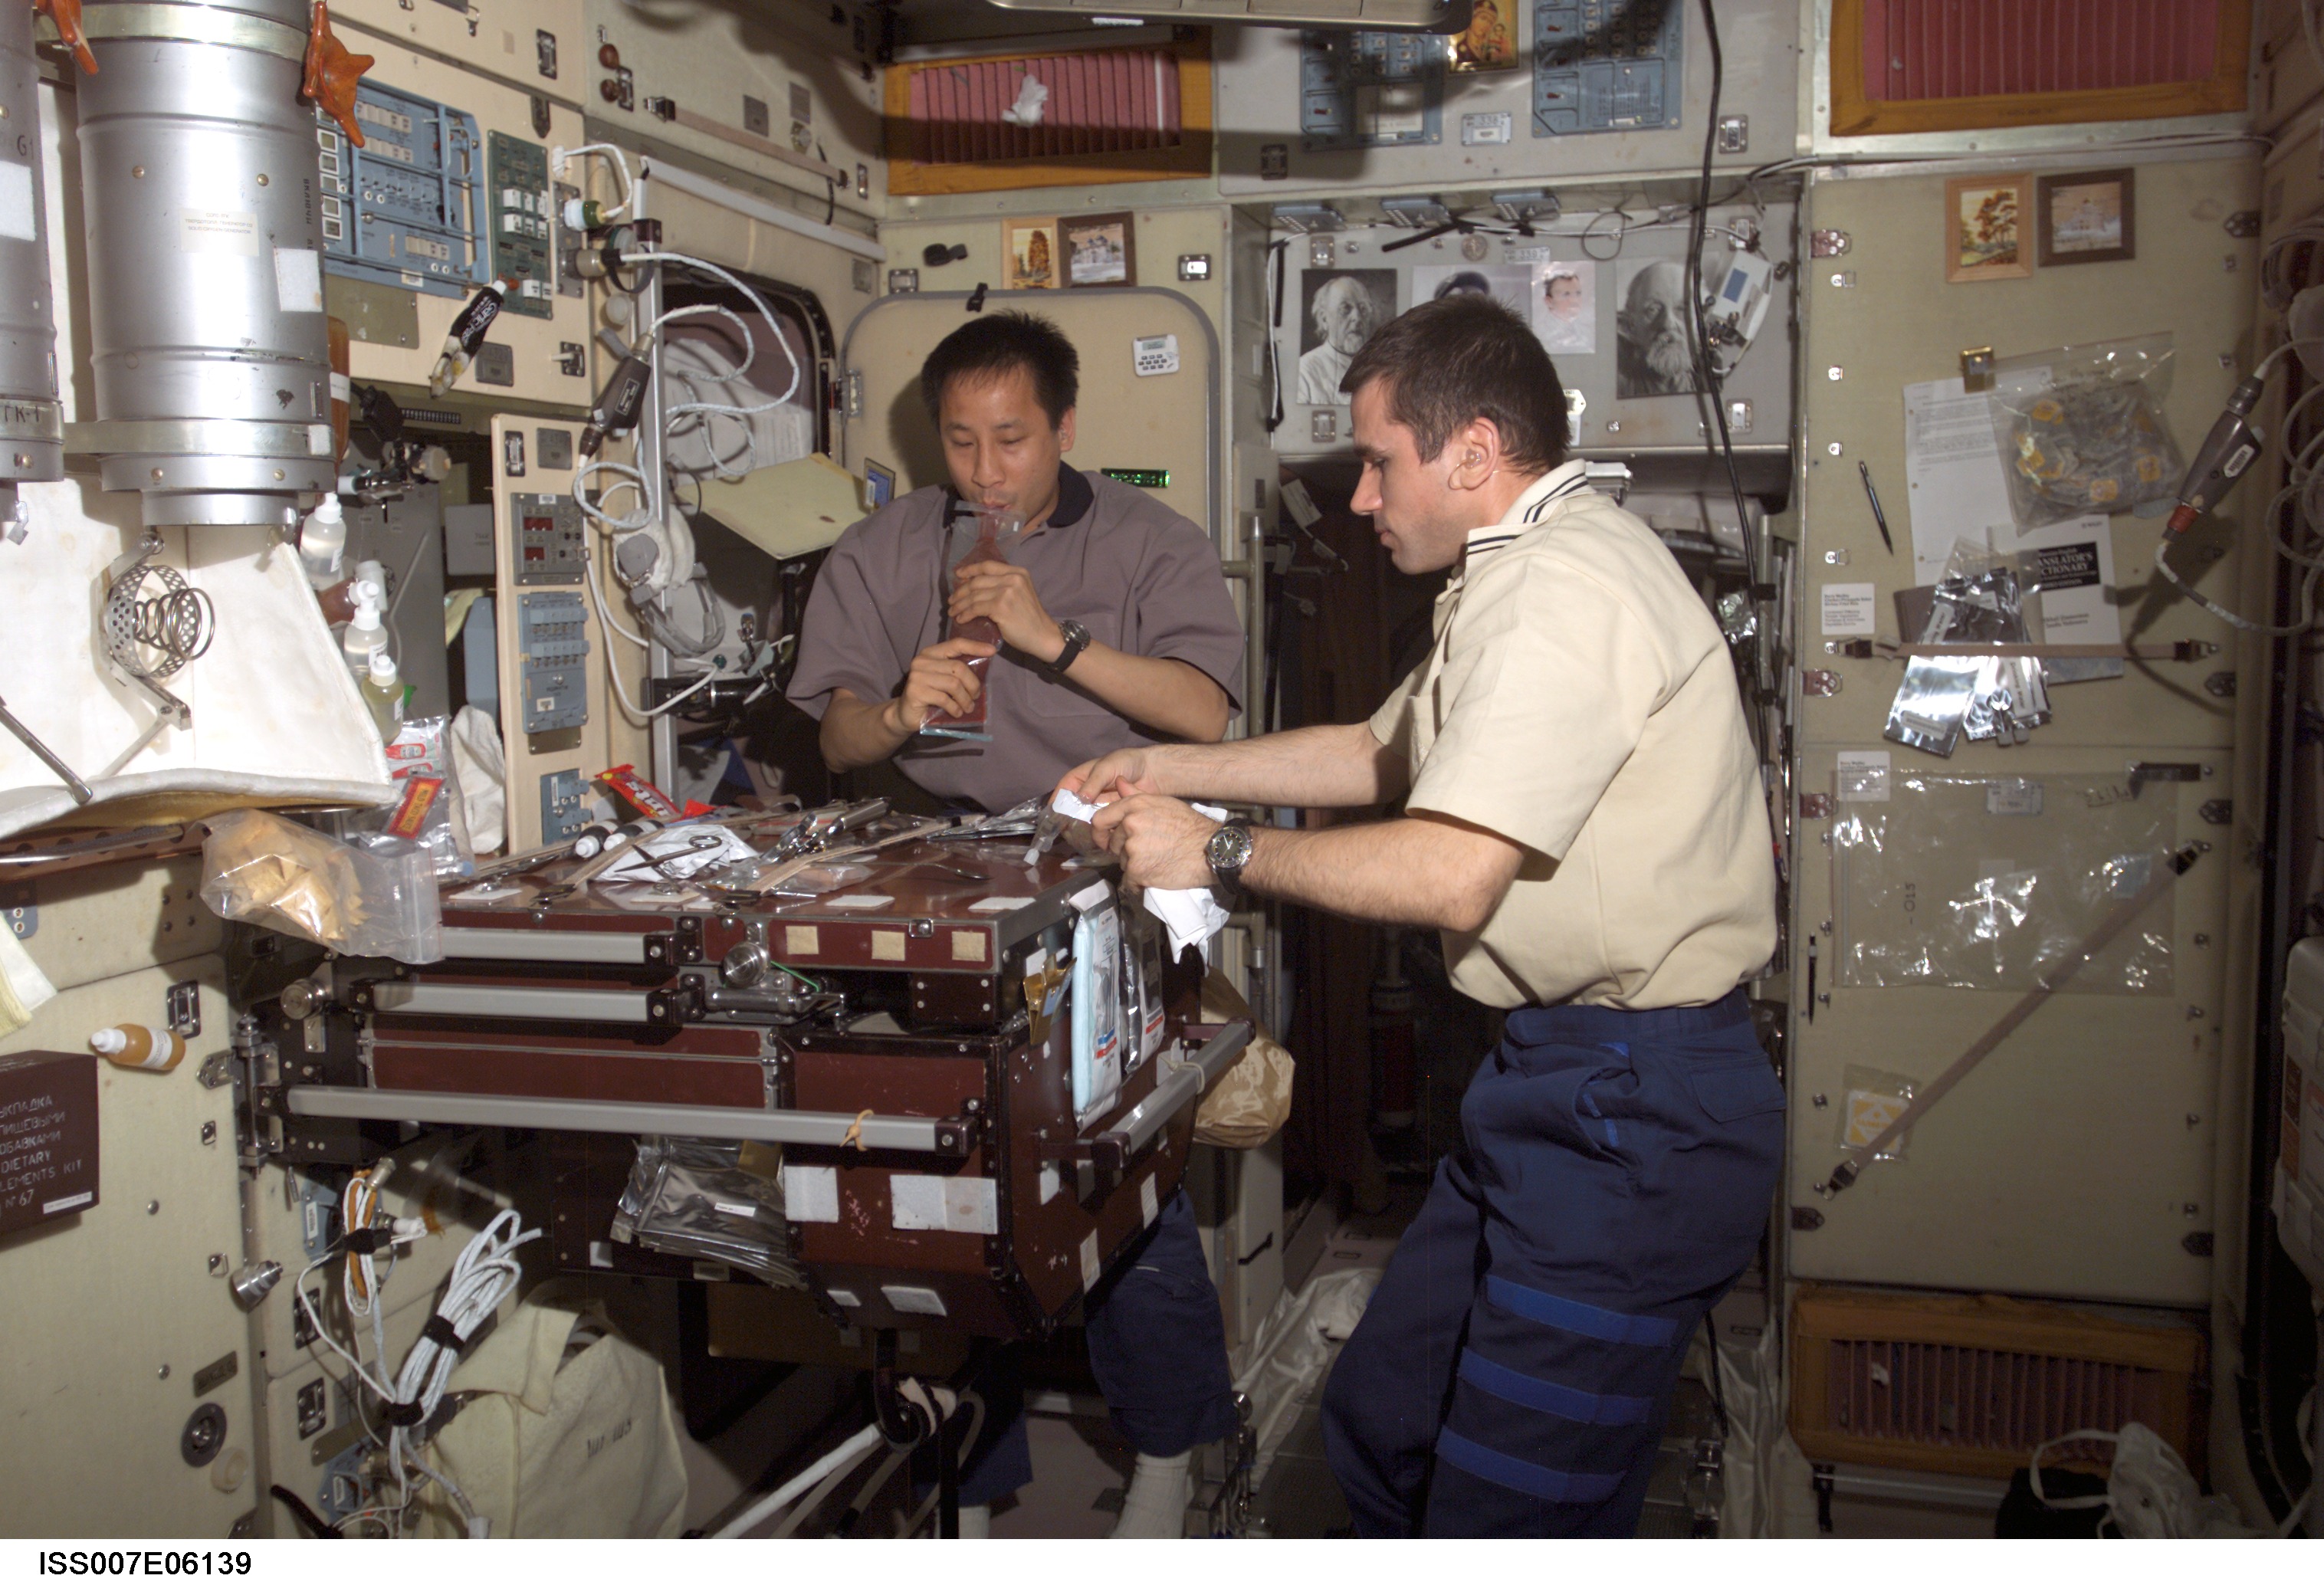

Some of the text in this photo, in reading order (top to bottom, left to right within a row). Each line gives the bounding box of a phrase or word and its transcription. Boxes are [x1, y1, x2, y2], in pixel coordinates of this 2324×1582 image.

[2037, 551, 2093, 567] ANSLATOR'S
[2040, 563, 2089, 576] CTIONARY
[0, 1131, 61, 1155] ОБАВКАМИ
[2, 1150, 51, 1173] DIETARY
[0, 1158, 82, 1193] LEMENTS KIT
[19, 1188, 34, 1207] 67
